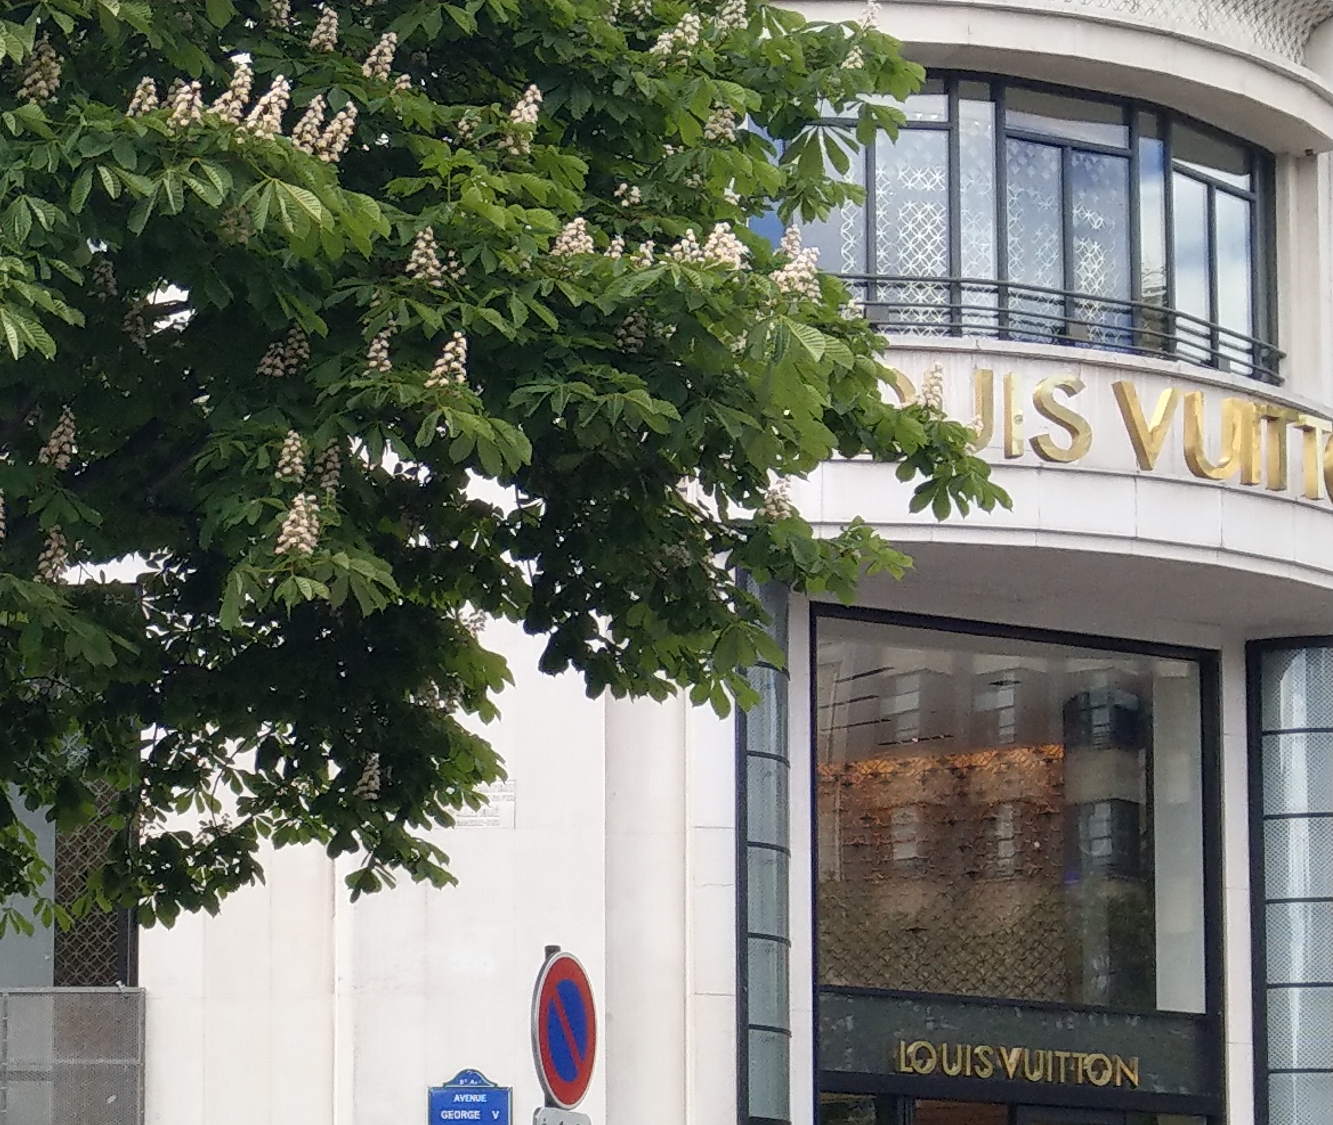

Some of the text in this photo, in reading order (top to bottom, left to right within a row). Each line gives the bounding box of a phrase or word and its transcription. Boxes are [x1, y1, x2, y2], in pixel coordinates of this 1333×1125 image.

[880, 365, 1333, 507] UIS VUITT
[898, 1039, 1139, 1088] LOUIS VUITTON
[453, 1093, 487, 1103] AVENUE
[440, 1109, 500, 1120] GEORGE V
